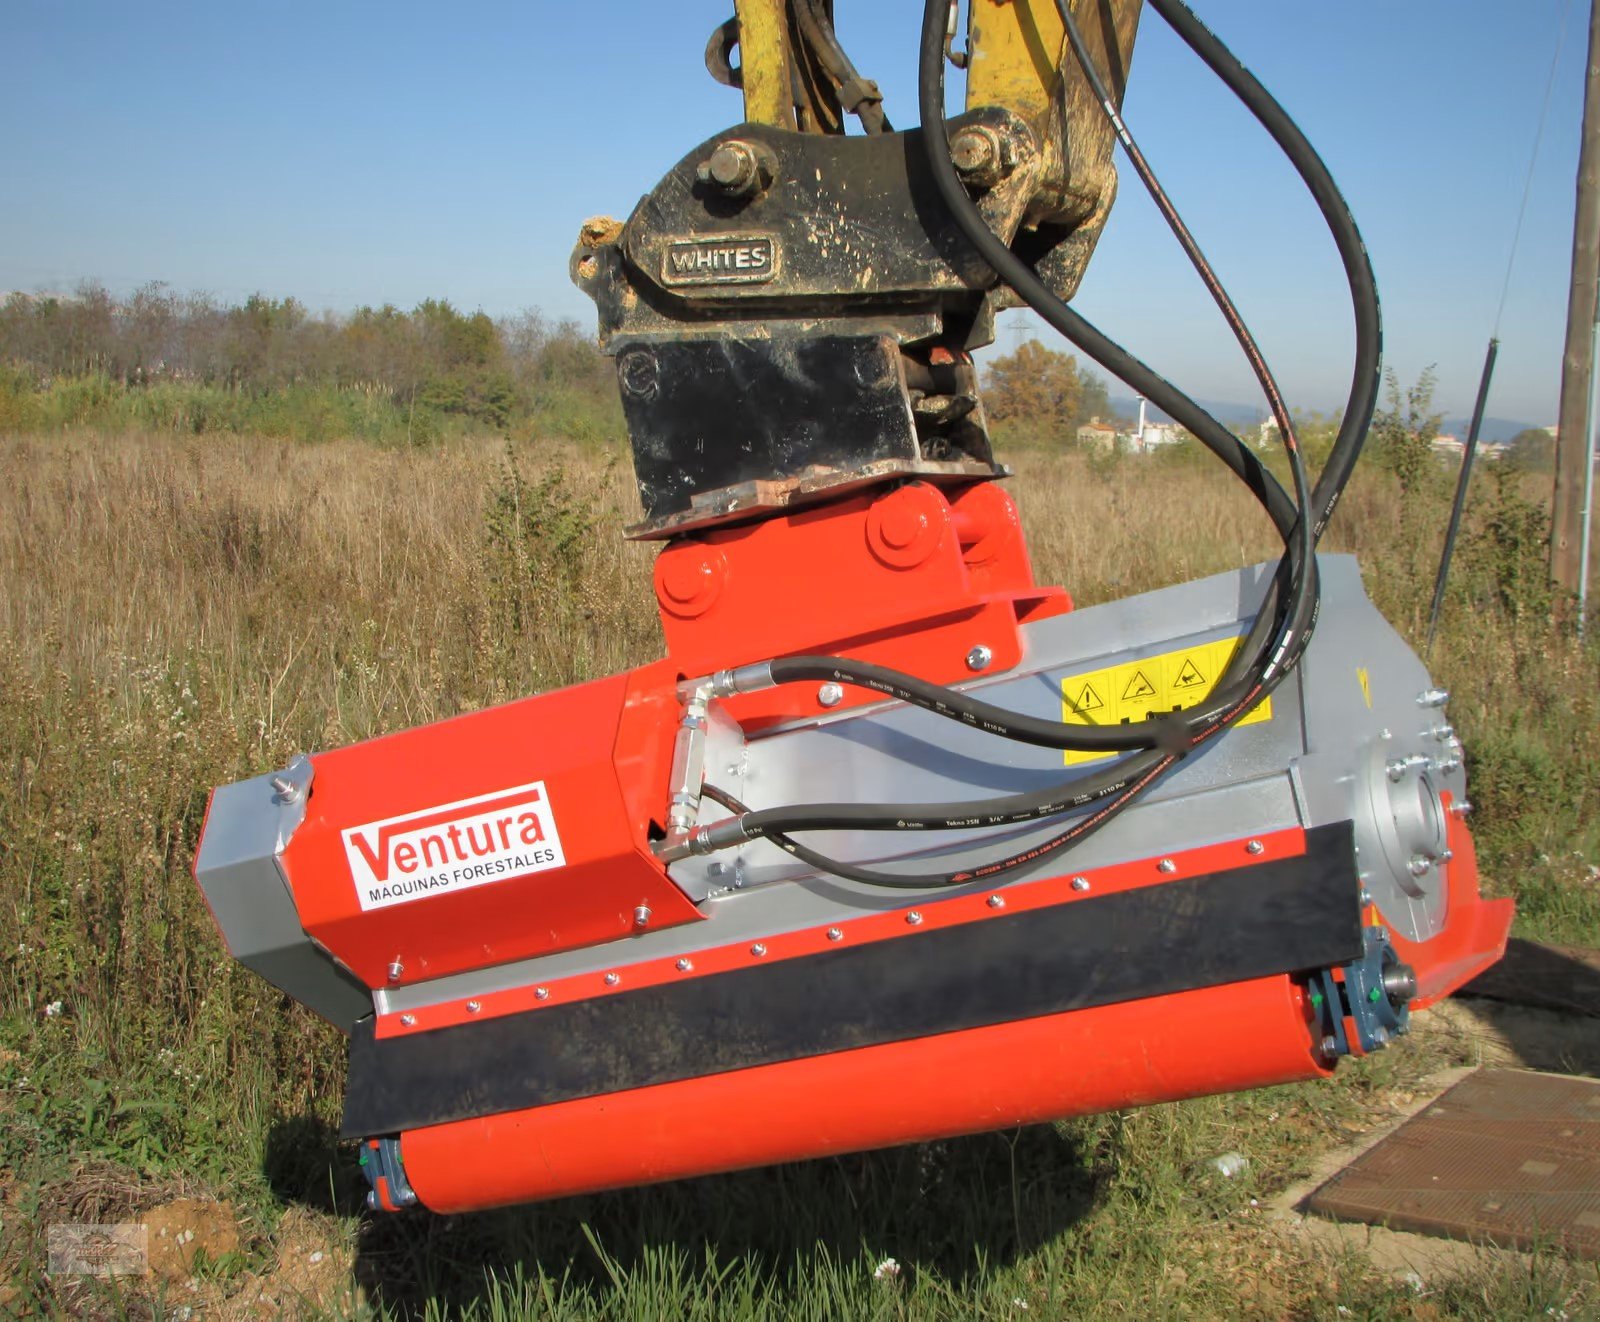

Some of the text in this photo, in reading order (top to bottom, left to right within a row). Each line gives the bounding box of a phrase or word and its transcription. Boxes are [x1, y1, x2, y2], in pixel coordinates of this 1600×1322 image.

[672, 247, 766, 272] WHITES
[350, 789, 546, 882] Ventura
[454, 848, 555, 882] FORESTALES
